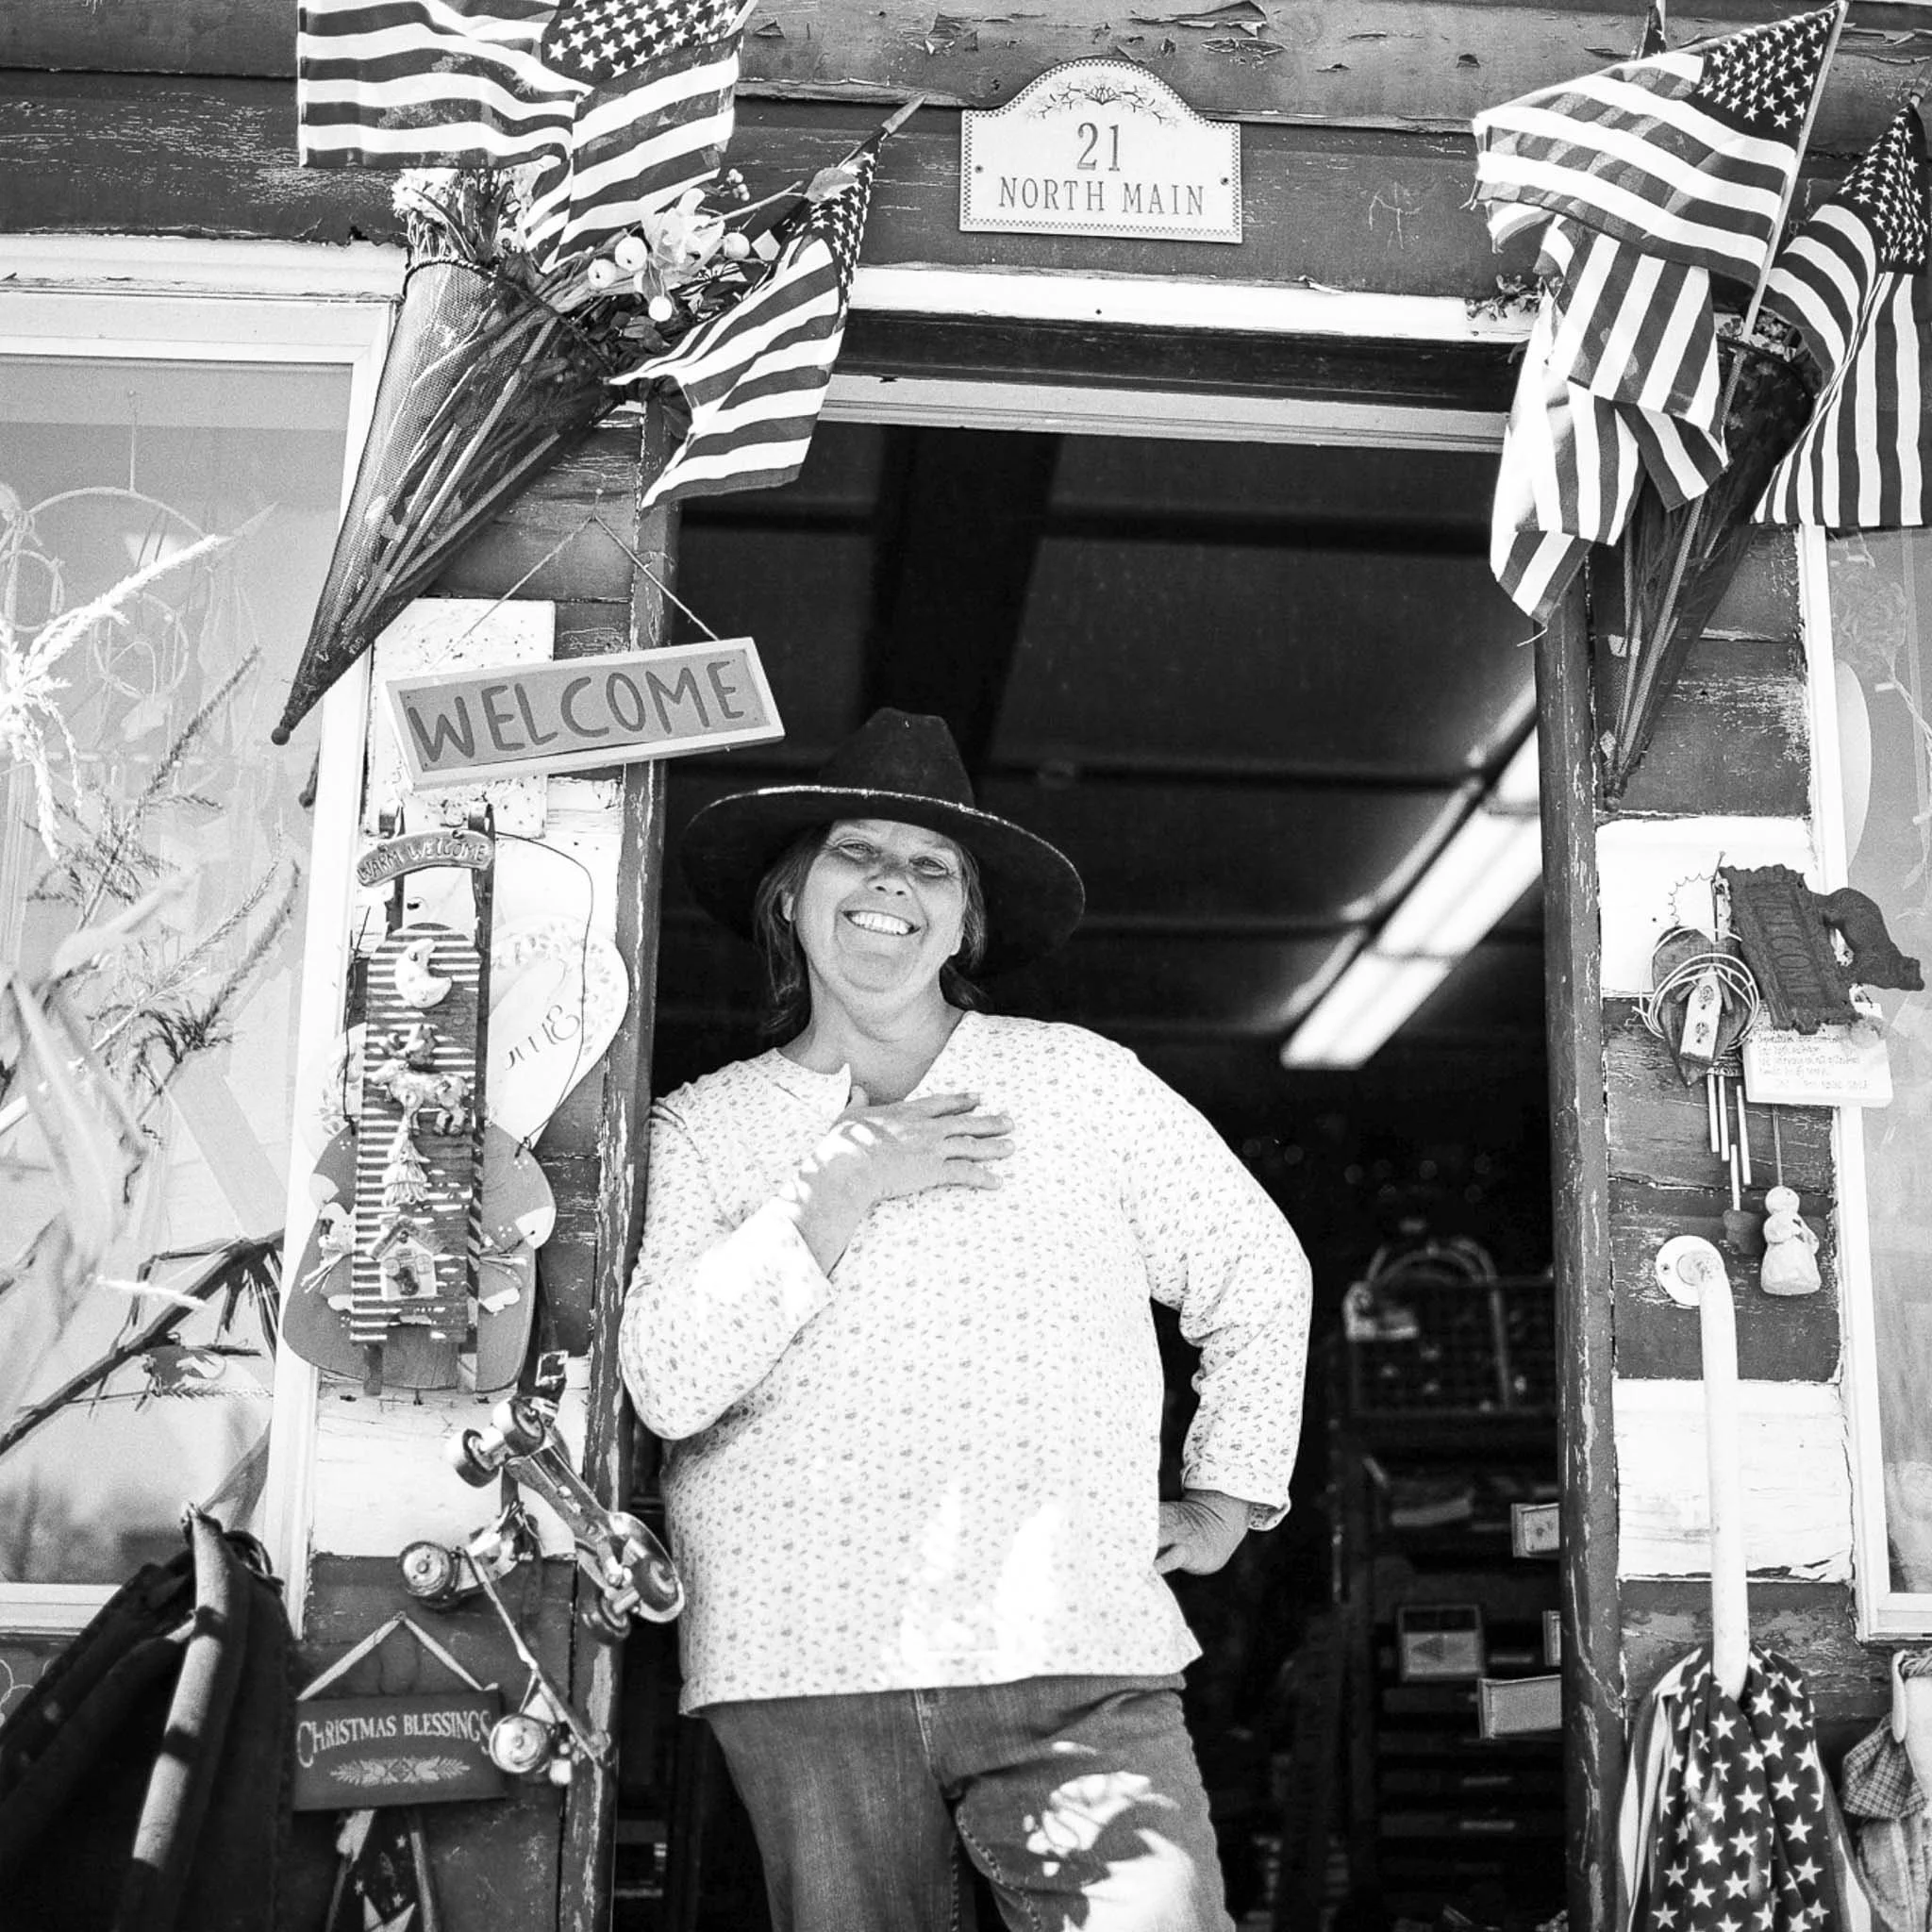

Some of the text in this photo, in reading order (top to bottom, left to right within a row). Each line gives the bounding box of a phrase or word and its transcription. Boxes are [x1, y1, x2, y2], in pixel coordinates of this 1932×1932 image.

[1076, 122, 1121, 172] 21
[998, 176, 1205, 216] NORTH MAIN
[408, 660, 744, 762] WELCOME
[357, 837, 488, 881] WARM WELCOME
[403, 1709, 491, 1755] BLESSINGS
